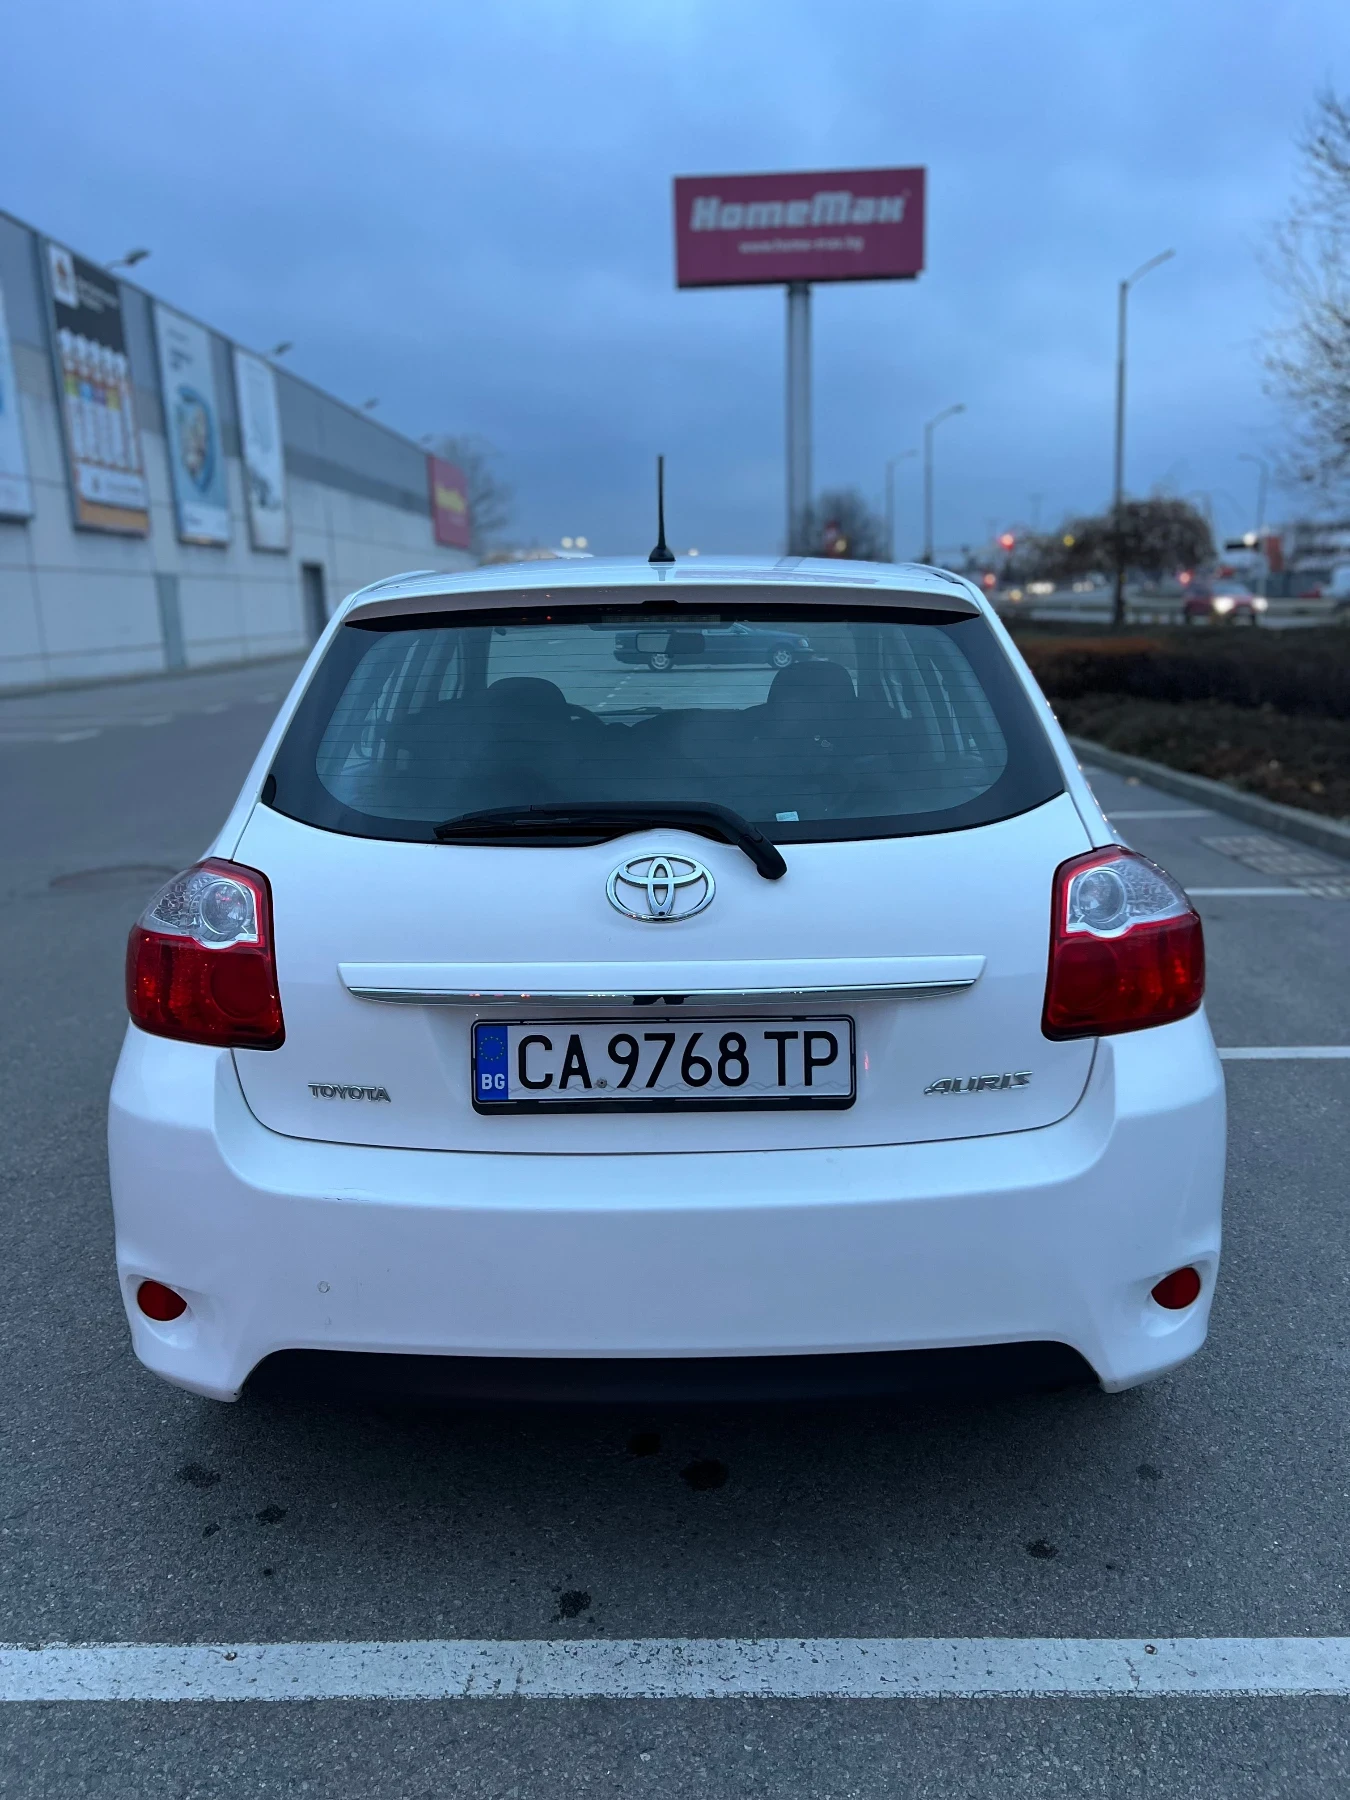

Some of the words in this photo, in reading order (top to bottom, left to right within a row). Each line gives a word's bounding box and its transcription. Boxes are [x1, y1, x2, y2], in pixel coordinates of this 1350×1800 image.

[690, 190, 905, 231] HomeMax
[518, 1034, 593, 1090] CA
[607, 1031, 750, 1089] 9768
[763, 1030, 839, 1088] TP
[307, 1082, 392, 1102] TOYOTA
[481, 1073, 505, 1090] BG
[924, 1070, 1033, 1095] AURIS
